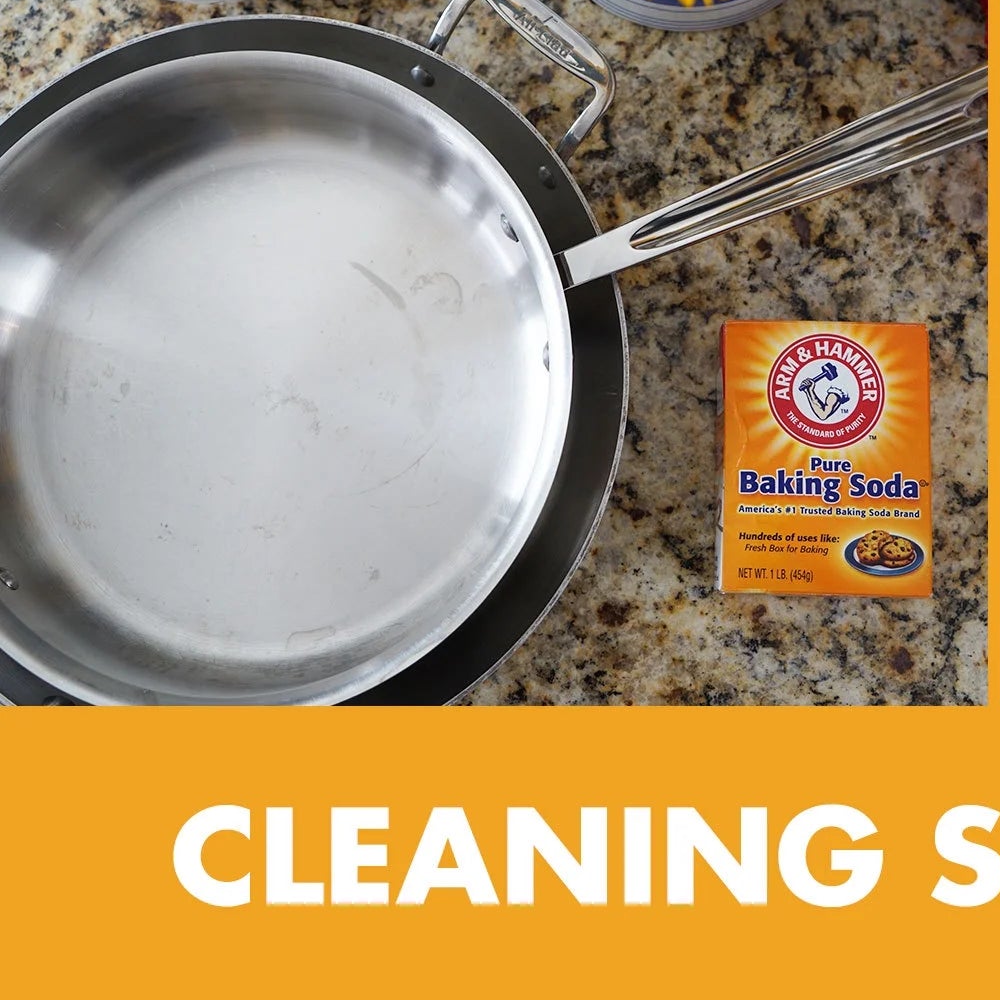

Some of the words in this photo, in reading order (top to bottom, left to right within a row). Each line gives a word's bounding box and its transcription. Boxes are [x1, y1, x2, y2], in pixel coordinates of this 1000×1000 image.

[774, 356, 800, 401] ARM
[796, 346, 813, 361] &
[814, 340, 878, 403] HAMMER
[786, 410, 800, 426] THE
[796, 421, 835, 438] STANDARD
[835, 428, 845, 437] OF
[845, 412, 867, 434] PURITY
[810, 457, 851, 472] Pure
[739, 469, 840, 503] Baking
[849, 472, 919, 499] Soda
[738, 504, 782, 514] America's
[785, 506, 796, 514] #1
[800, 506, 833, 516] Trusted
[835, 507, 866, 518] Baking
[869, 508, 891, 517] Soda
[894, 509, 920, 518] Brand
[738, 531, 783, 542] Hundreds
[785, 532, 796, 542] of
[797, 534, 818, 543] uses
[820, 533, 840, 543] like:
[744, 543, 767, 552] Fresh
[768, 544, 785, 553] Box
[786, 544, 799, 554] for
[800, 545, 829, 556] Baking
[738, 567, 753, 579] NET
[754, 567, 768, 579] WT.
[770, 568, 774, 580] 1
[776, 568, 788, 580] LB.
[789, 569, 814, 583] (454g)
